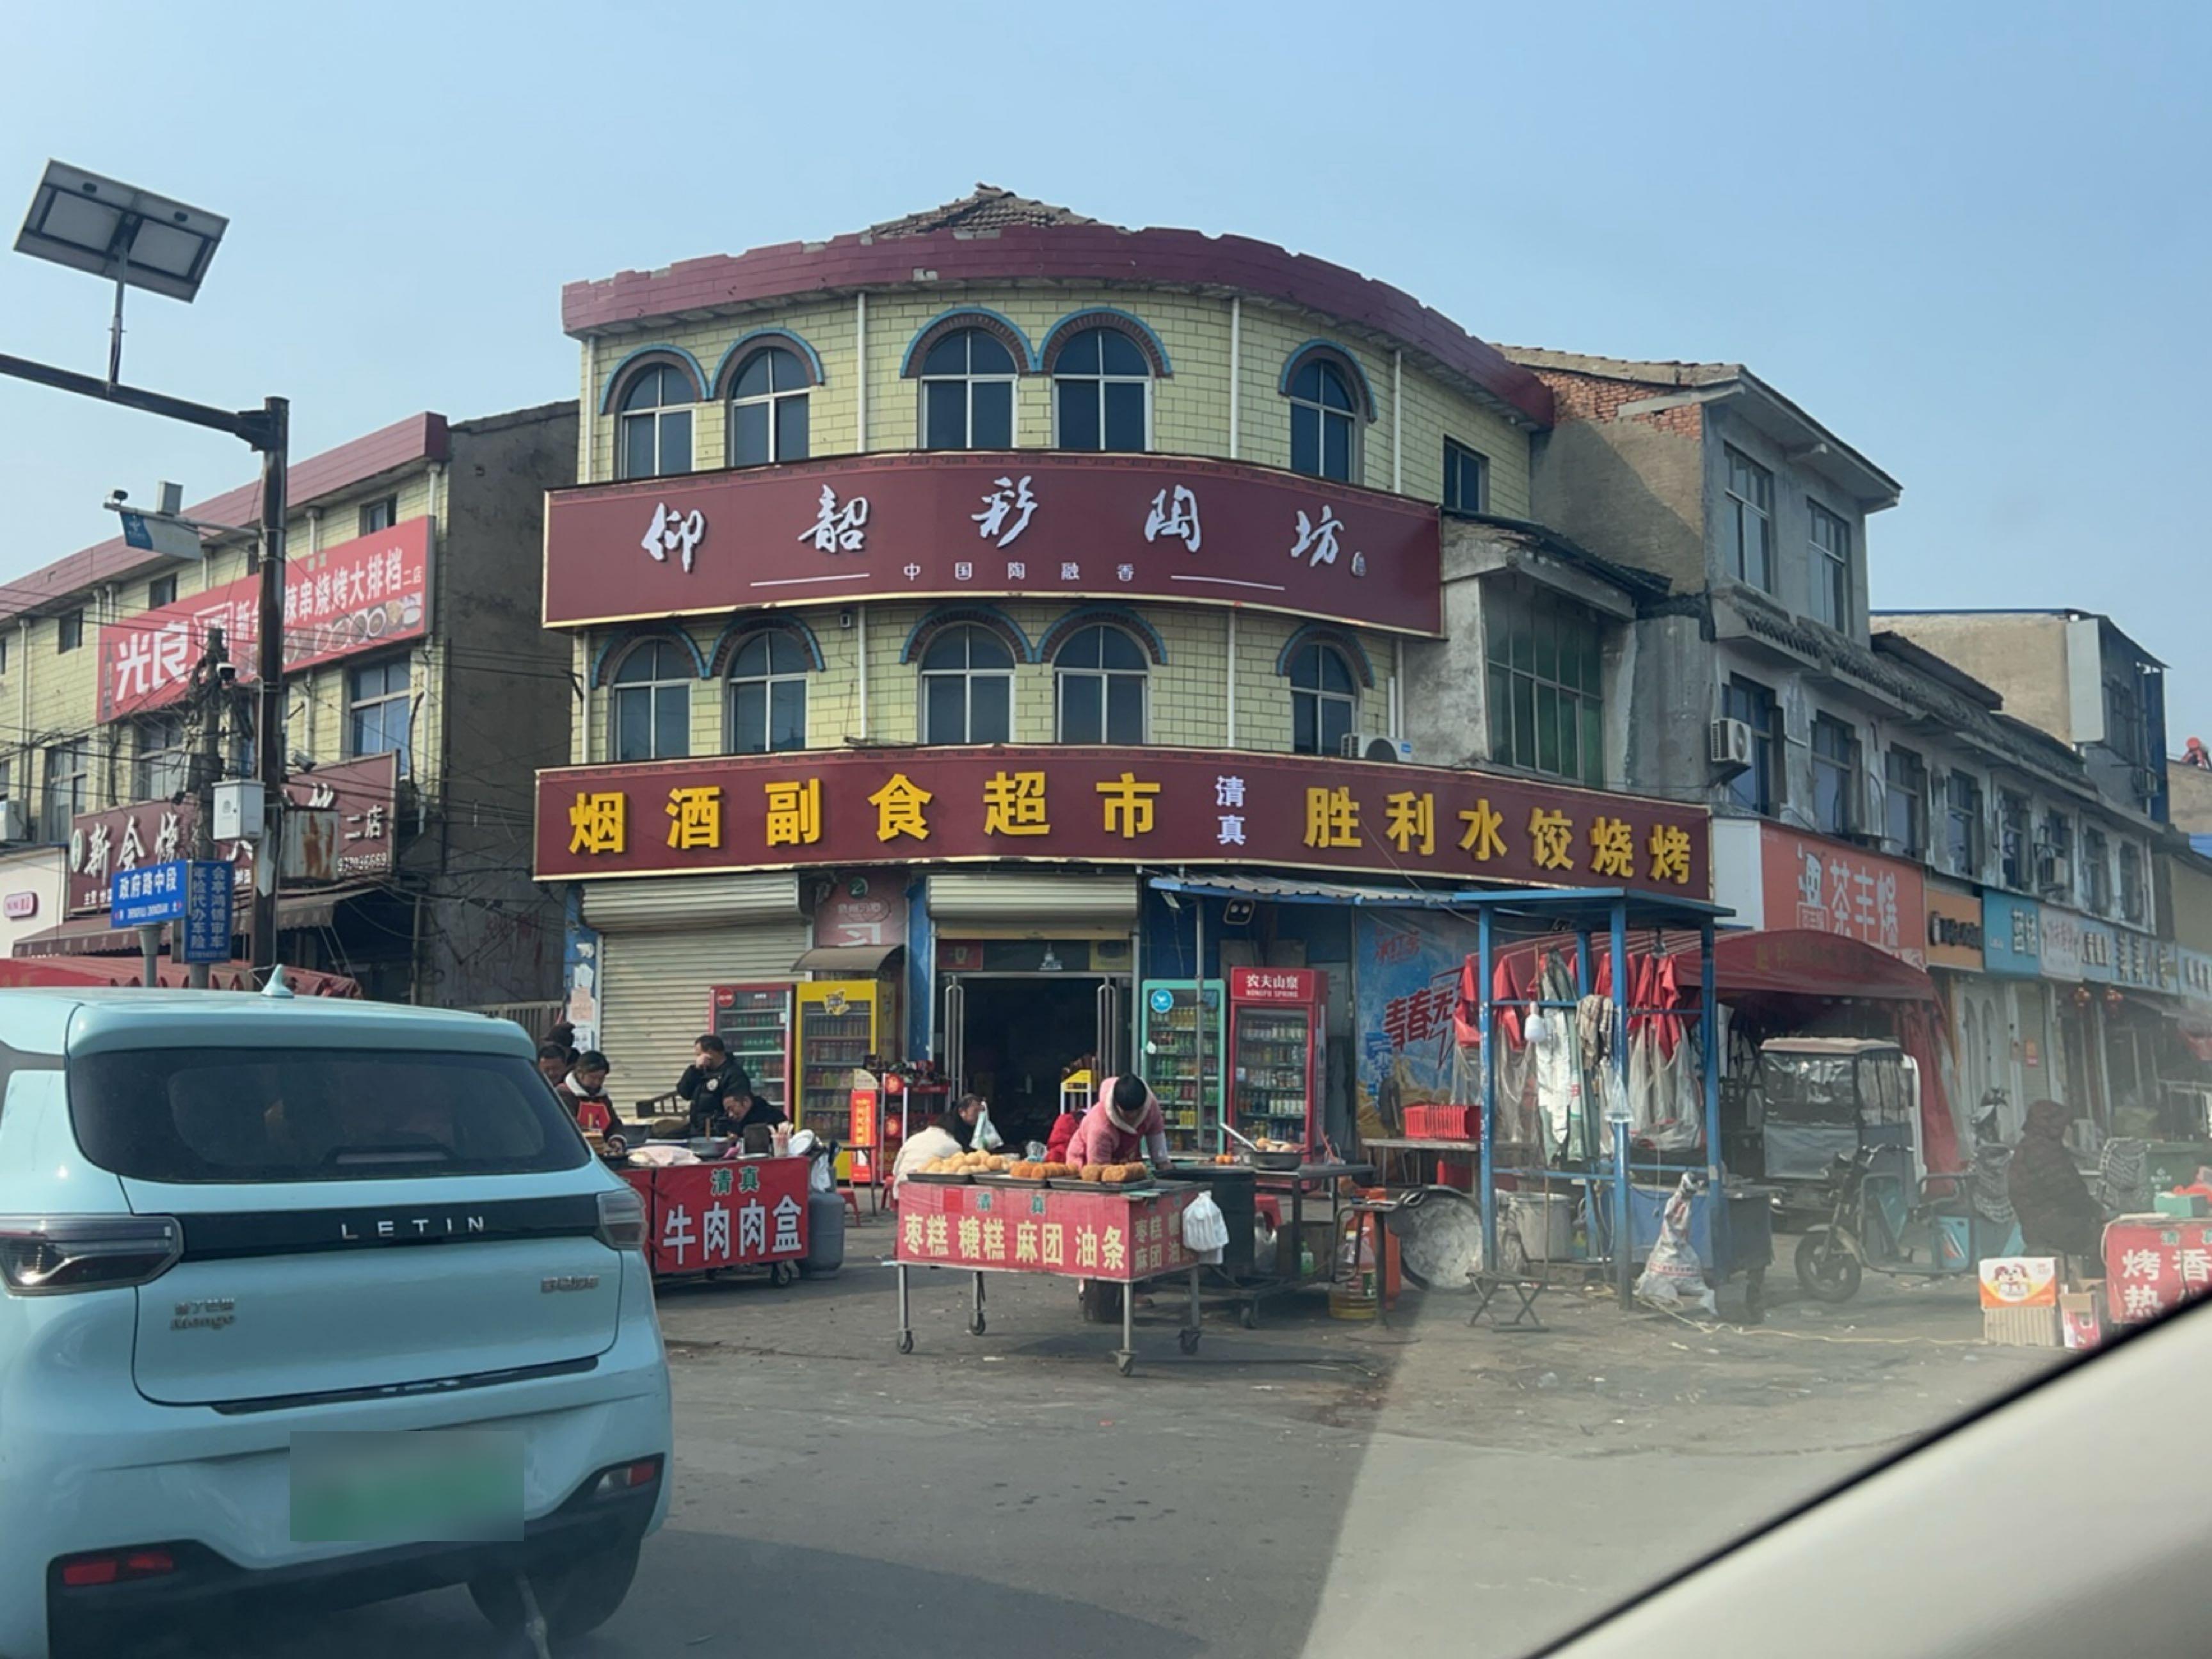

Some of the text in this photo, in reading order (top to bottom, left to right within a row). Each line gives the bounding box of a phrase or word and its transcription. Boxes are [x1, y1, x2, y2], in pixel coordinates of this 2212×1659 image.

[642, 476, 1344, 573] 仰韶彩陶坊
[904, 562, 1134, 581] 中国陶融香
[345, 805, 383, 839] 二店
[568, 771, 1160, 854] 烟酒副食超市
[1215, 775, 1246, 846] 清真
[1304, 787, 1690, 884] 胜利水饺烧烤
[119, 866, 177, 900] 政府路中段
[1246, 974, 1299, 990] 农夫山泉
[710, 1166, 760, 1196] 清真
[976, 1192, 1046, 1215] 清真
[341, 1215, 485, 1239] LETIN
[662, 1194, 803, 1265] 牛肉肉盒
[904, 1213, 1126, 1270] 枣糕 糖糕 麻团 油条
